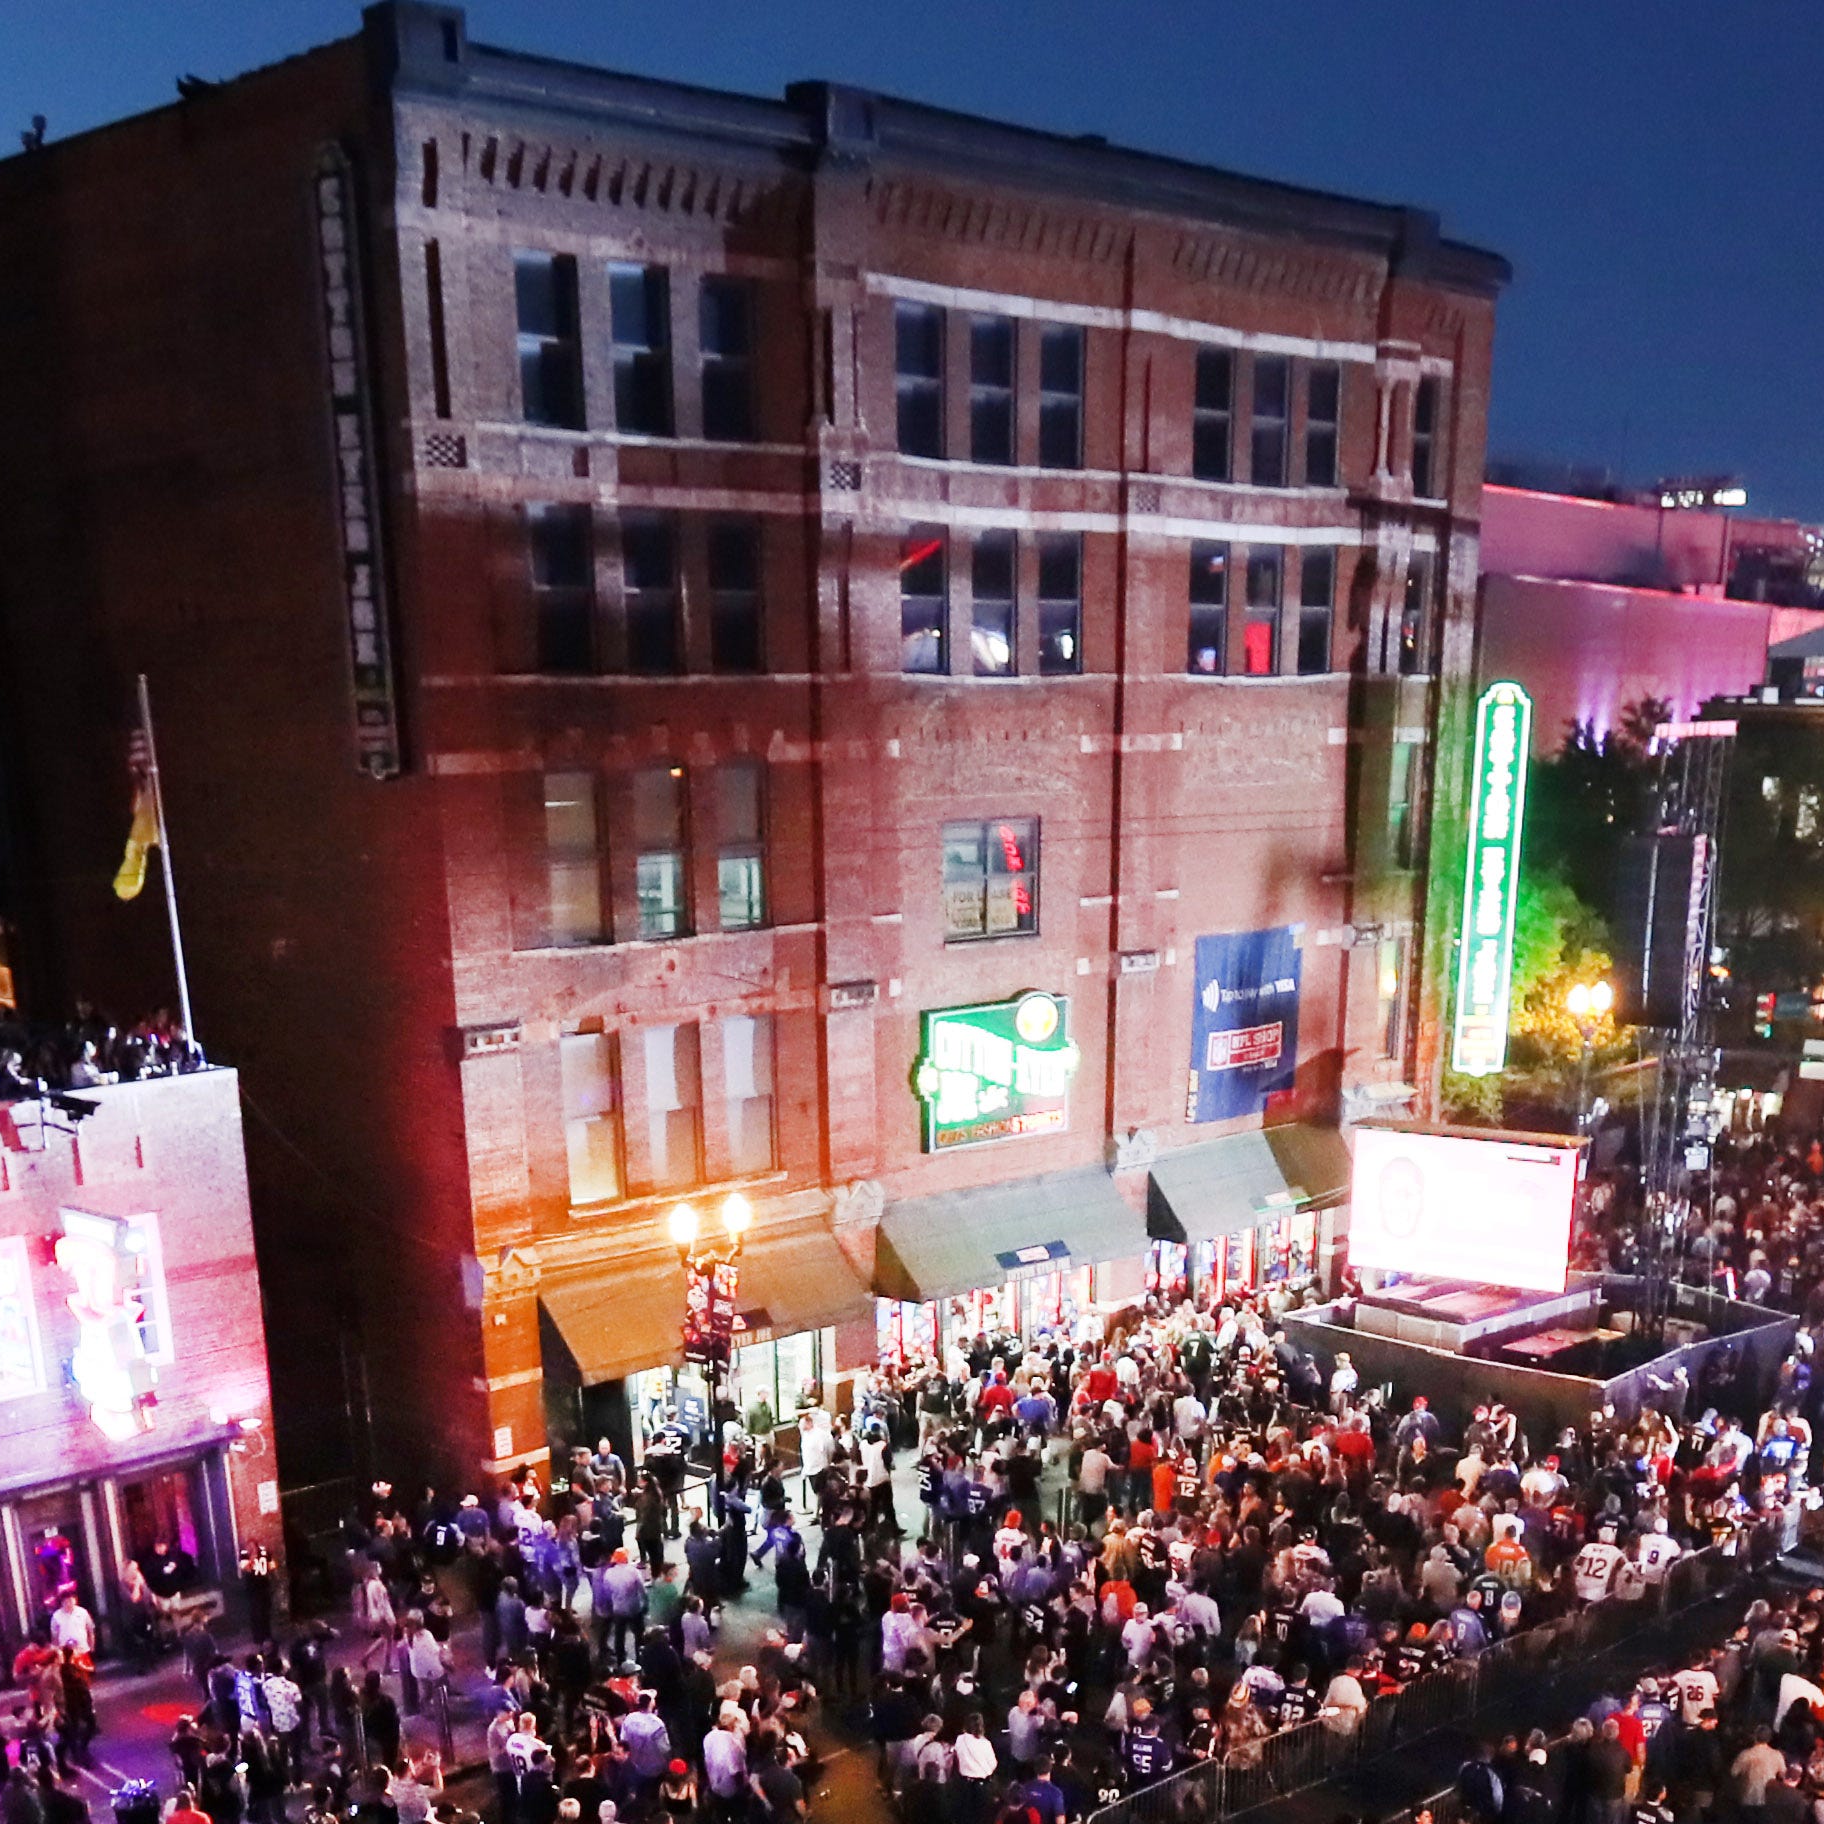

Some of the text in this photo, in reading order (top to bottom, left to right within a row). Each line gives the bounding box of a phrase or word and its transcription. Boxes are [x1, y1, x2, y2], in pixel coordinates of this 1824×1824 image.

[1189, 1341, 1200, 1357] 7
[1180, 1482, 1195, 1497] 12
[1647, 1550, 1659, 1564] 9
[1583, 1558, 1607, 1579] 12
[1642, 1719, 1661, 1738] 27
[1097, 1788, 1119, 1804] 90
